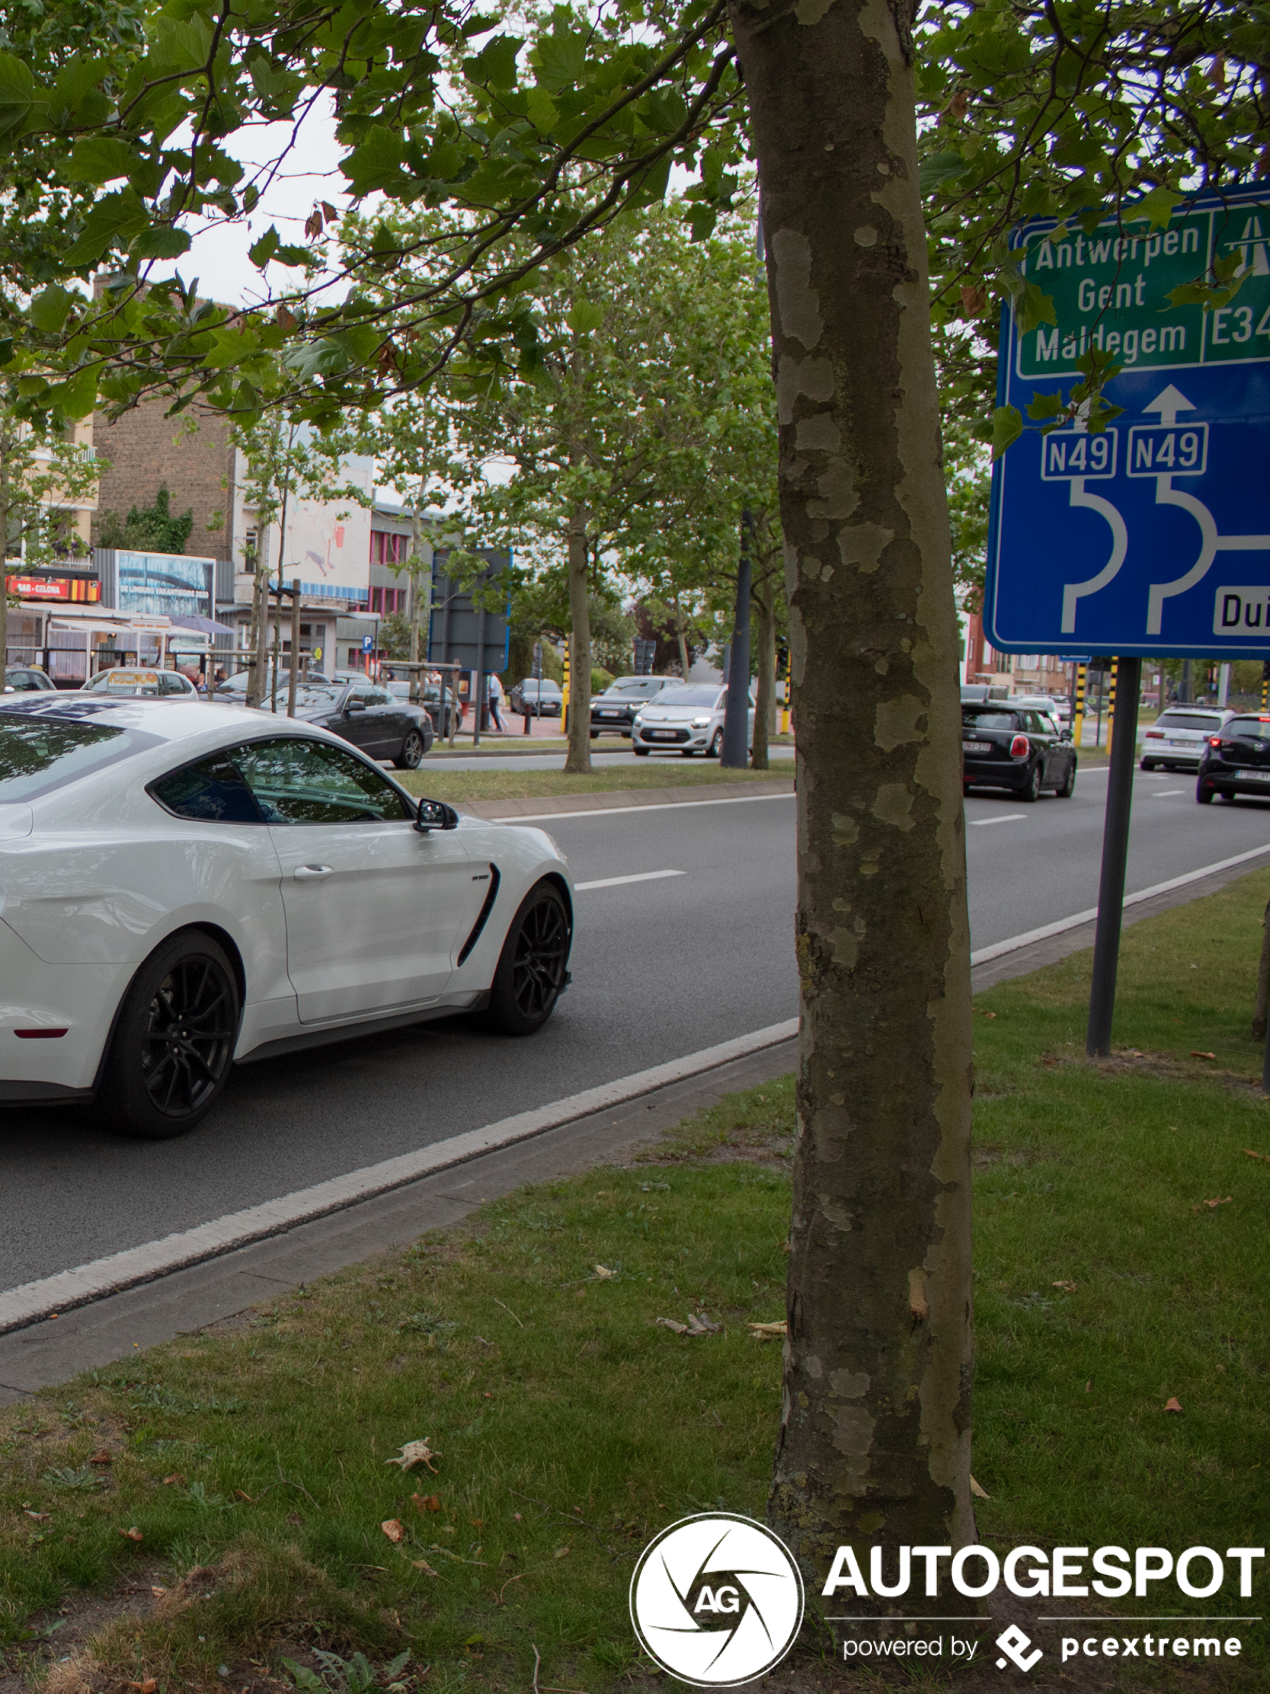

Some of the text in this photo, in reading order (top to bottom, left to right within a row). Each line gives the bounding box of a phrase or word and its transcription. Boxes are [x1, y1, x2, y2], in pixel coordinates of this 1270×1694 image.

[1035, 227, 1199, 271] Antwerpen
[1078, 274, 1147, 312] Gent
[1035, 324, 1186, 364] Maldegem
[1049, 436, 1109, 472] N49
[1135, 432, 1199, 469] N49
[130, 585, 155, 594] LIMBURG
[195, 590, 209, 599] 2020
[364, 636, 372, 648] P
